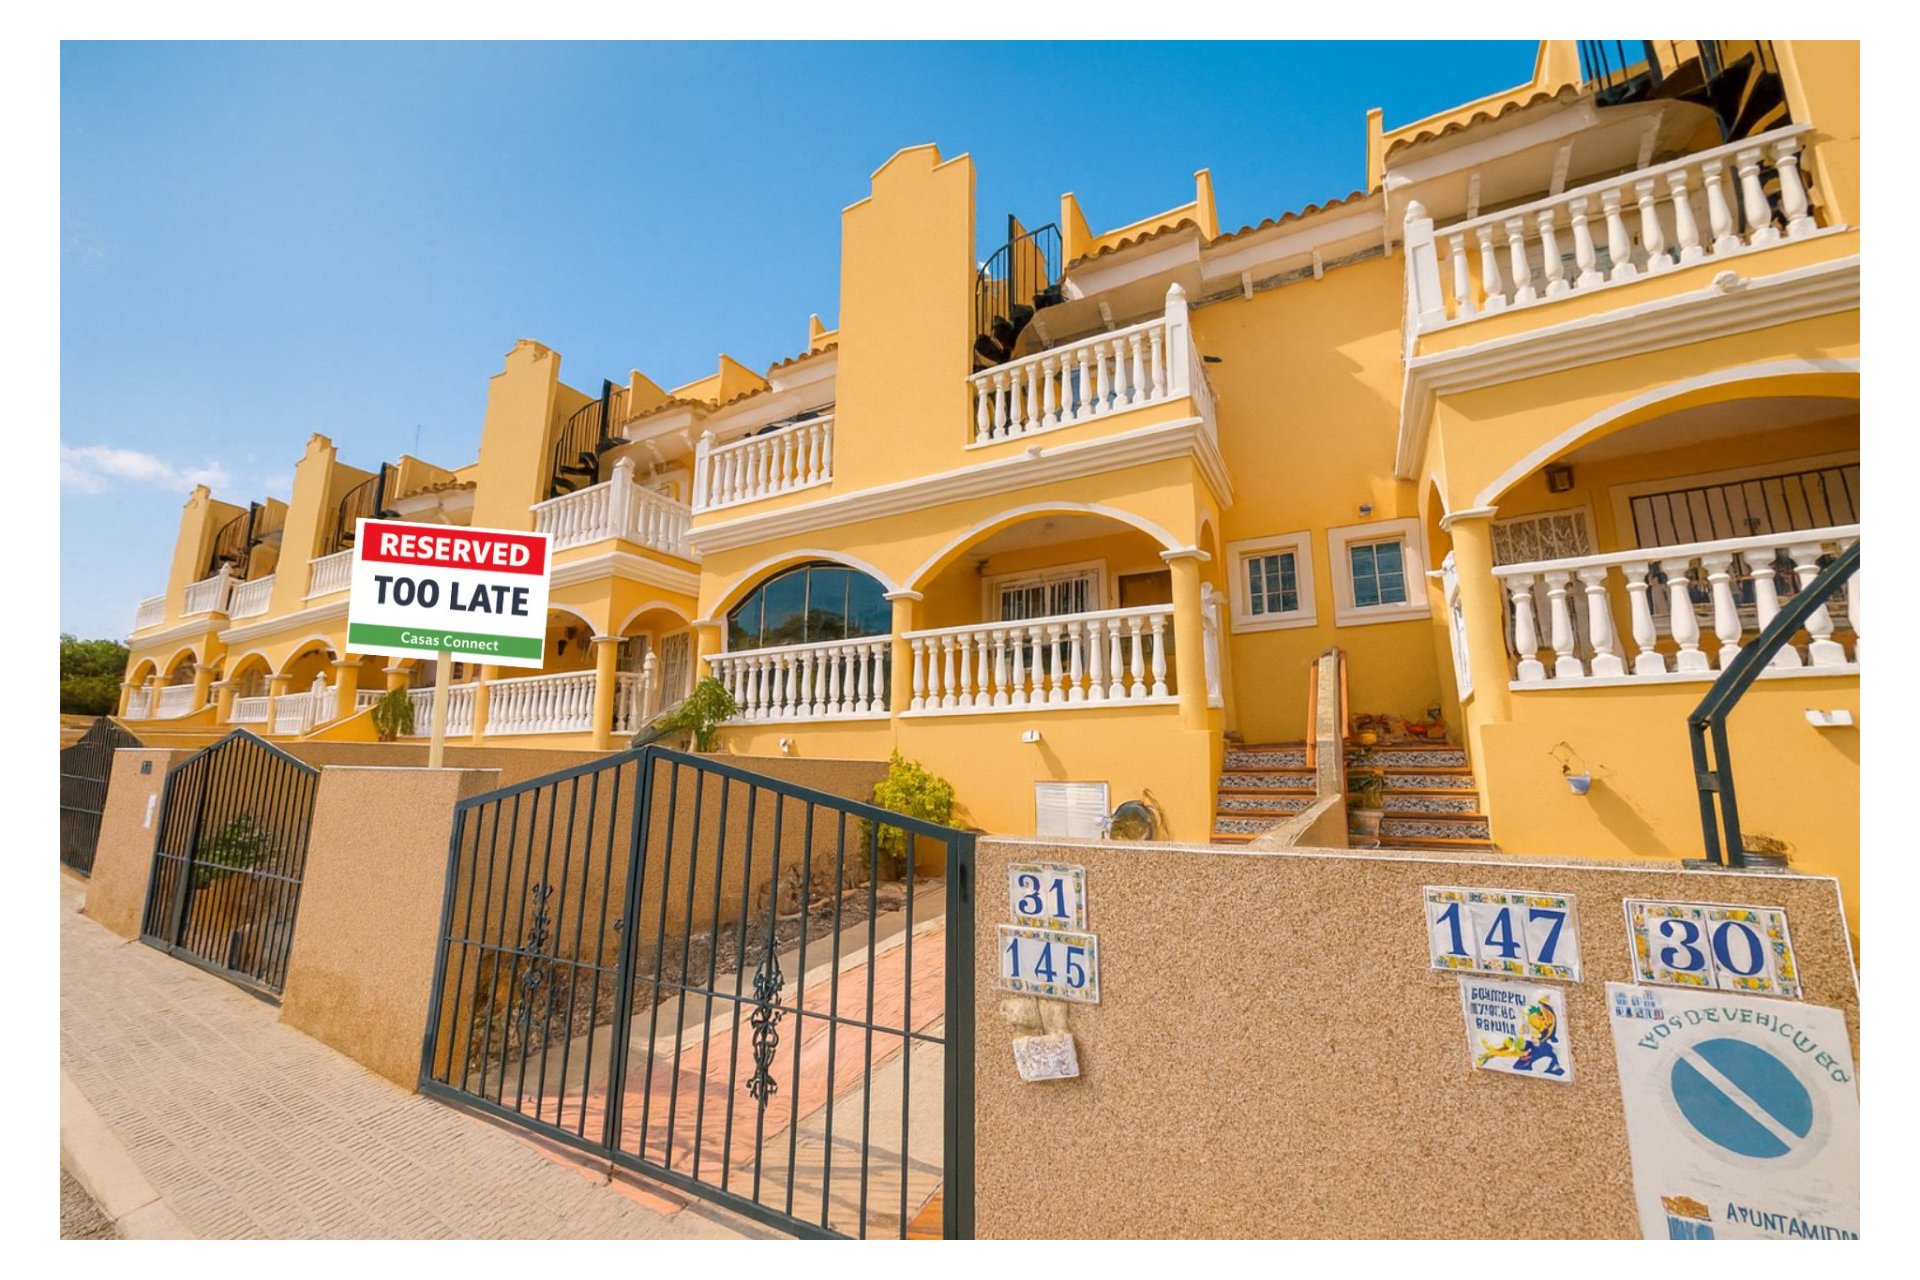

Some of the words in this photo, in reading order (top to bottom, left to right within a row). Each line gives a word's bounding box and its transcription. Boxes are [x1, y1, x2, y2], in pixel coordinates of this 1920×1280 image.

[379, 532, 531, 567] RESERVED
[374, 574, 440, 609] TOO
[449, 581, 530, 617] LATE
[400, 631, 440, 647] Casas
[442, 635, 500, 652] Connect
[1017, 874, 1071, 919] 31
[1436, 902, 1567, 965] 147
[1659, 918, 1766, 977] 30
[1005, 937, 1086, 990] 145
